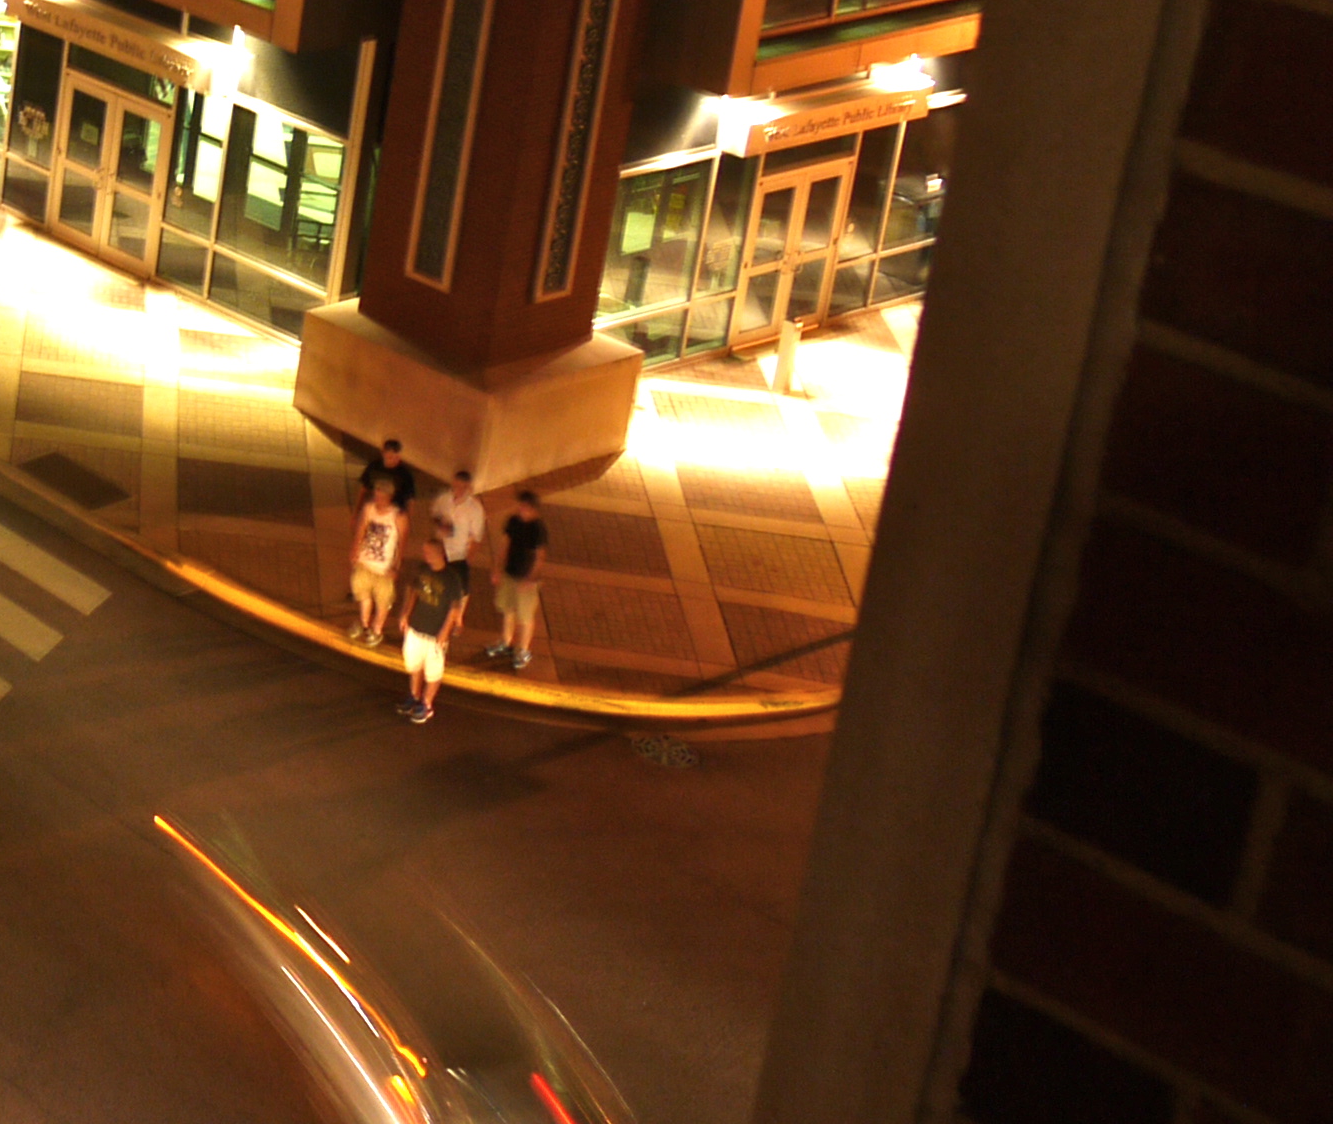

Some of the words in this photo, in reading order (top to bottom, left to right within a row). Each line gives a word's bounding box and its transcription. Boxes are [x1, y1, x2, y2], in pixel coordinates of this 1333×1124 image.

[55, 14, 107, 45] Lafayette
[110, 34, 146, 59] Public
[842, 108, 875, 126] Public
